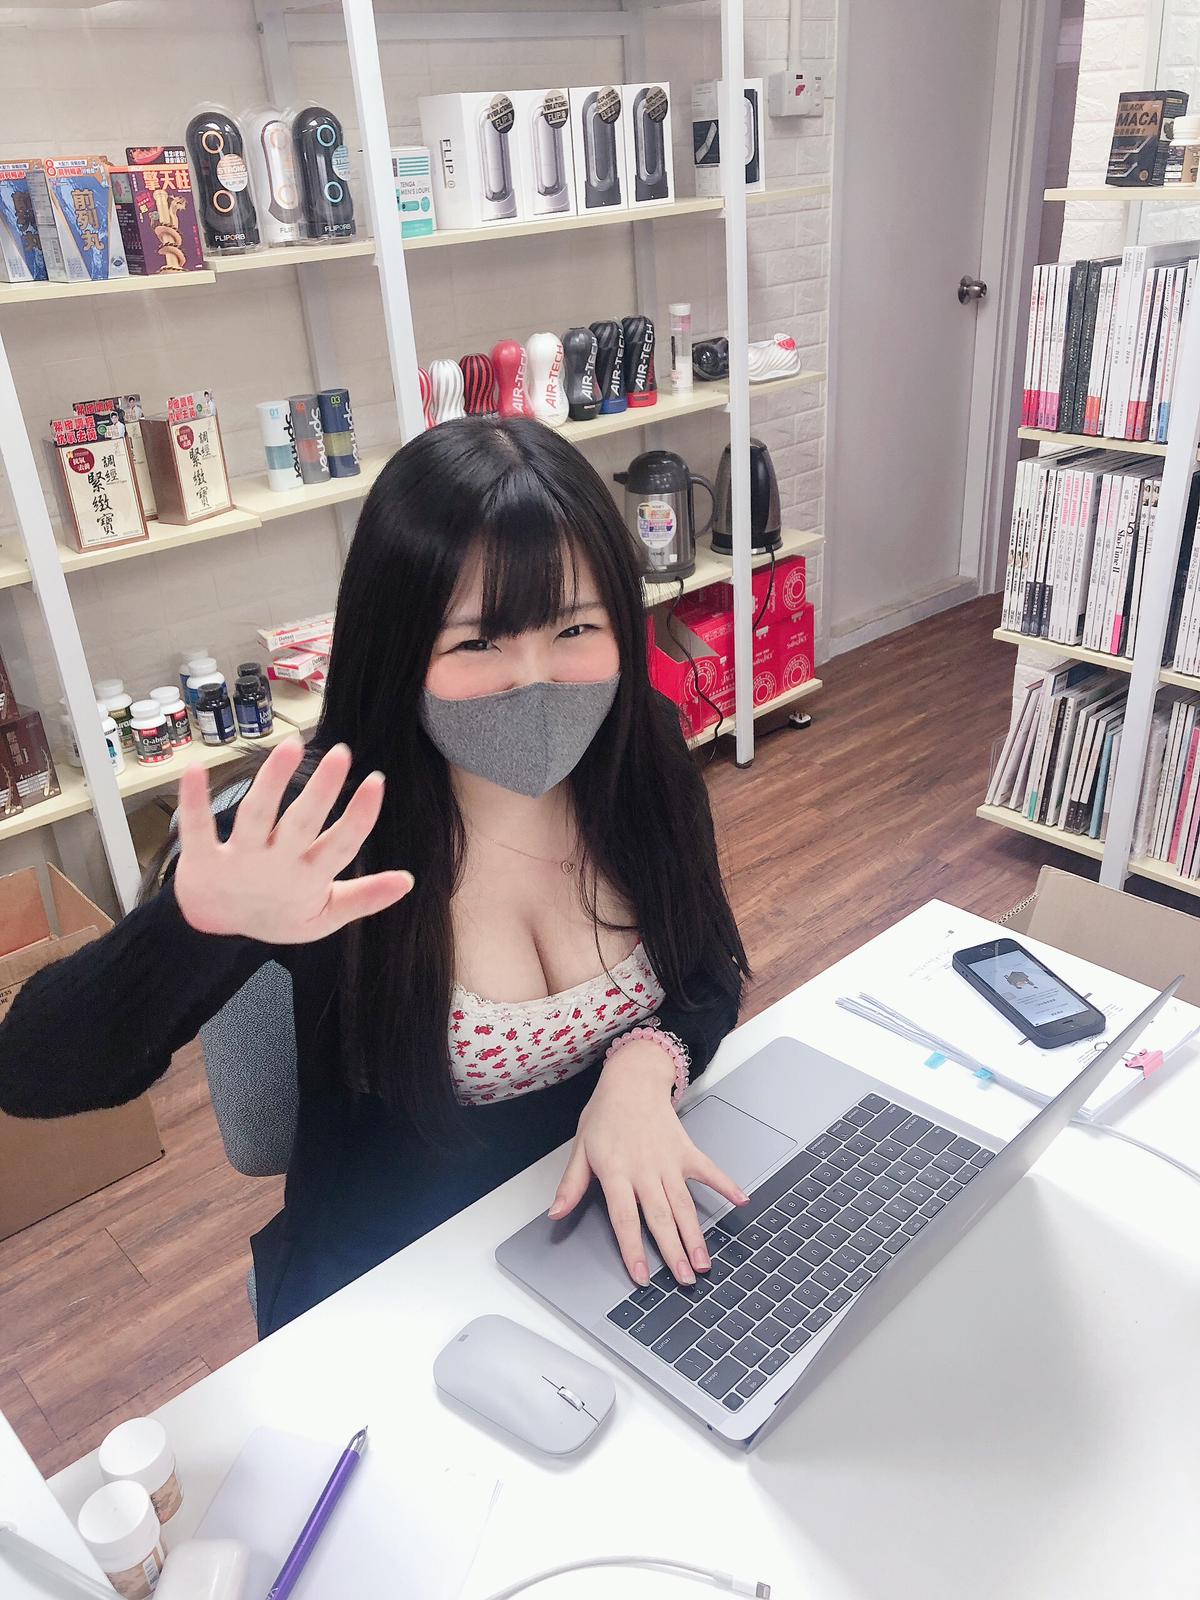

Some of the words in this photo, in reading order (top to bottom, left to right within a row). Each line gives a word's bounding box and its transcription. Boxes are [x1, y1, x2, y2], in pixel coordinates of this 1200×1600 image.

[1120, 103, 1144, 111] BLACK
[495, 115, 508, 127] FLIP
[548, 112, 561, 120] FLIP
[1116, 112, 1158, 127] MACA
[443, 139, 455, 174] FLIP
[143, 170, 191, 191] 擎天柱
[71, 188, 105, 251] 前列丸
[325, 224, 352, 233] FLIPORB
[214, 233, 246, 242] FLIPORB
[610, 328, 626, 397] AIR-TECH
[635, 323, 654, 391] AIR-TECH
[581, 336, 598, 401] AIR-TECH
[512, 347, 528, 414] AIR-TECH
[545, 344, 564, 409] AIR-TECH
[331, 396, 341, 404] 03
[269, 408, 279, 417] 01
[1114, 529, 1125, 565] Sho-Time
[635, 1323, 646, 1333] shift
[656, 1337, 671, 1350] return
[704, 1371, 719, 1385] delete
